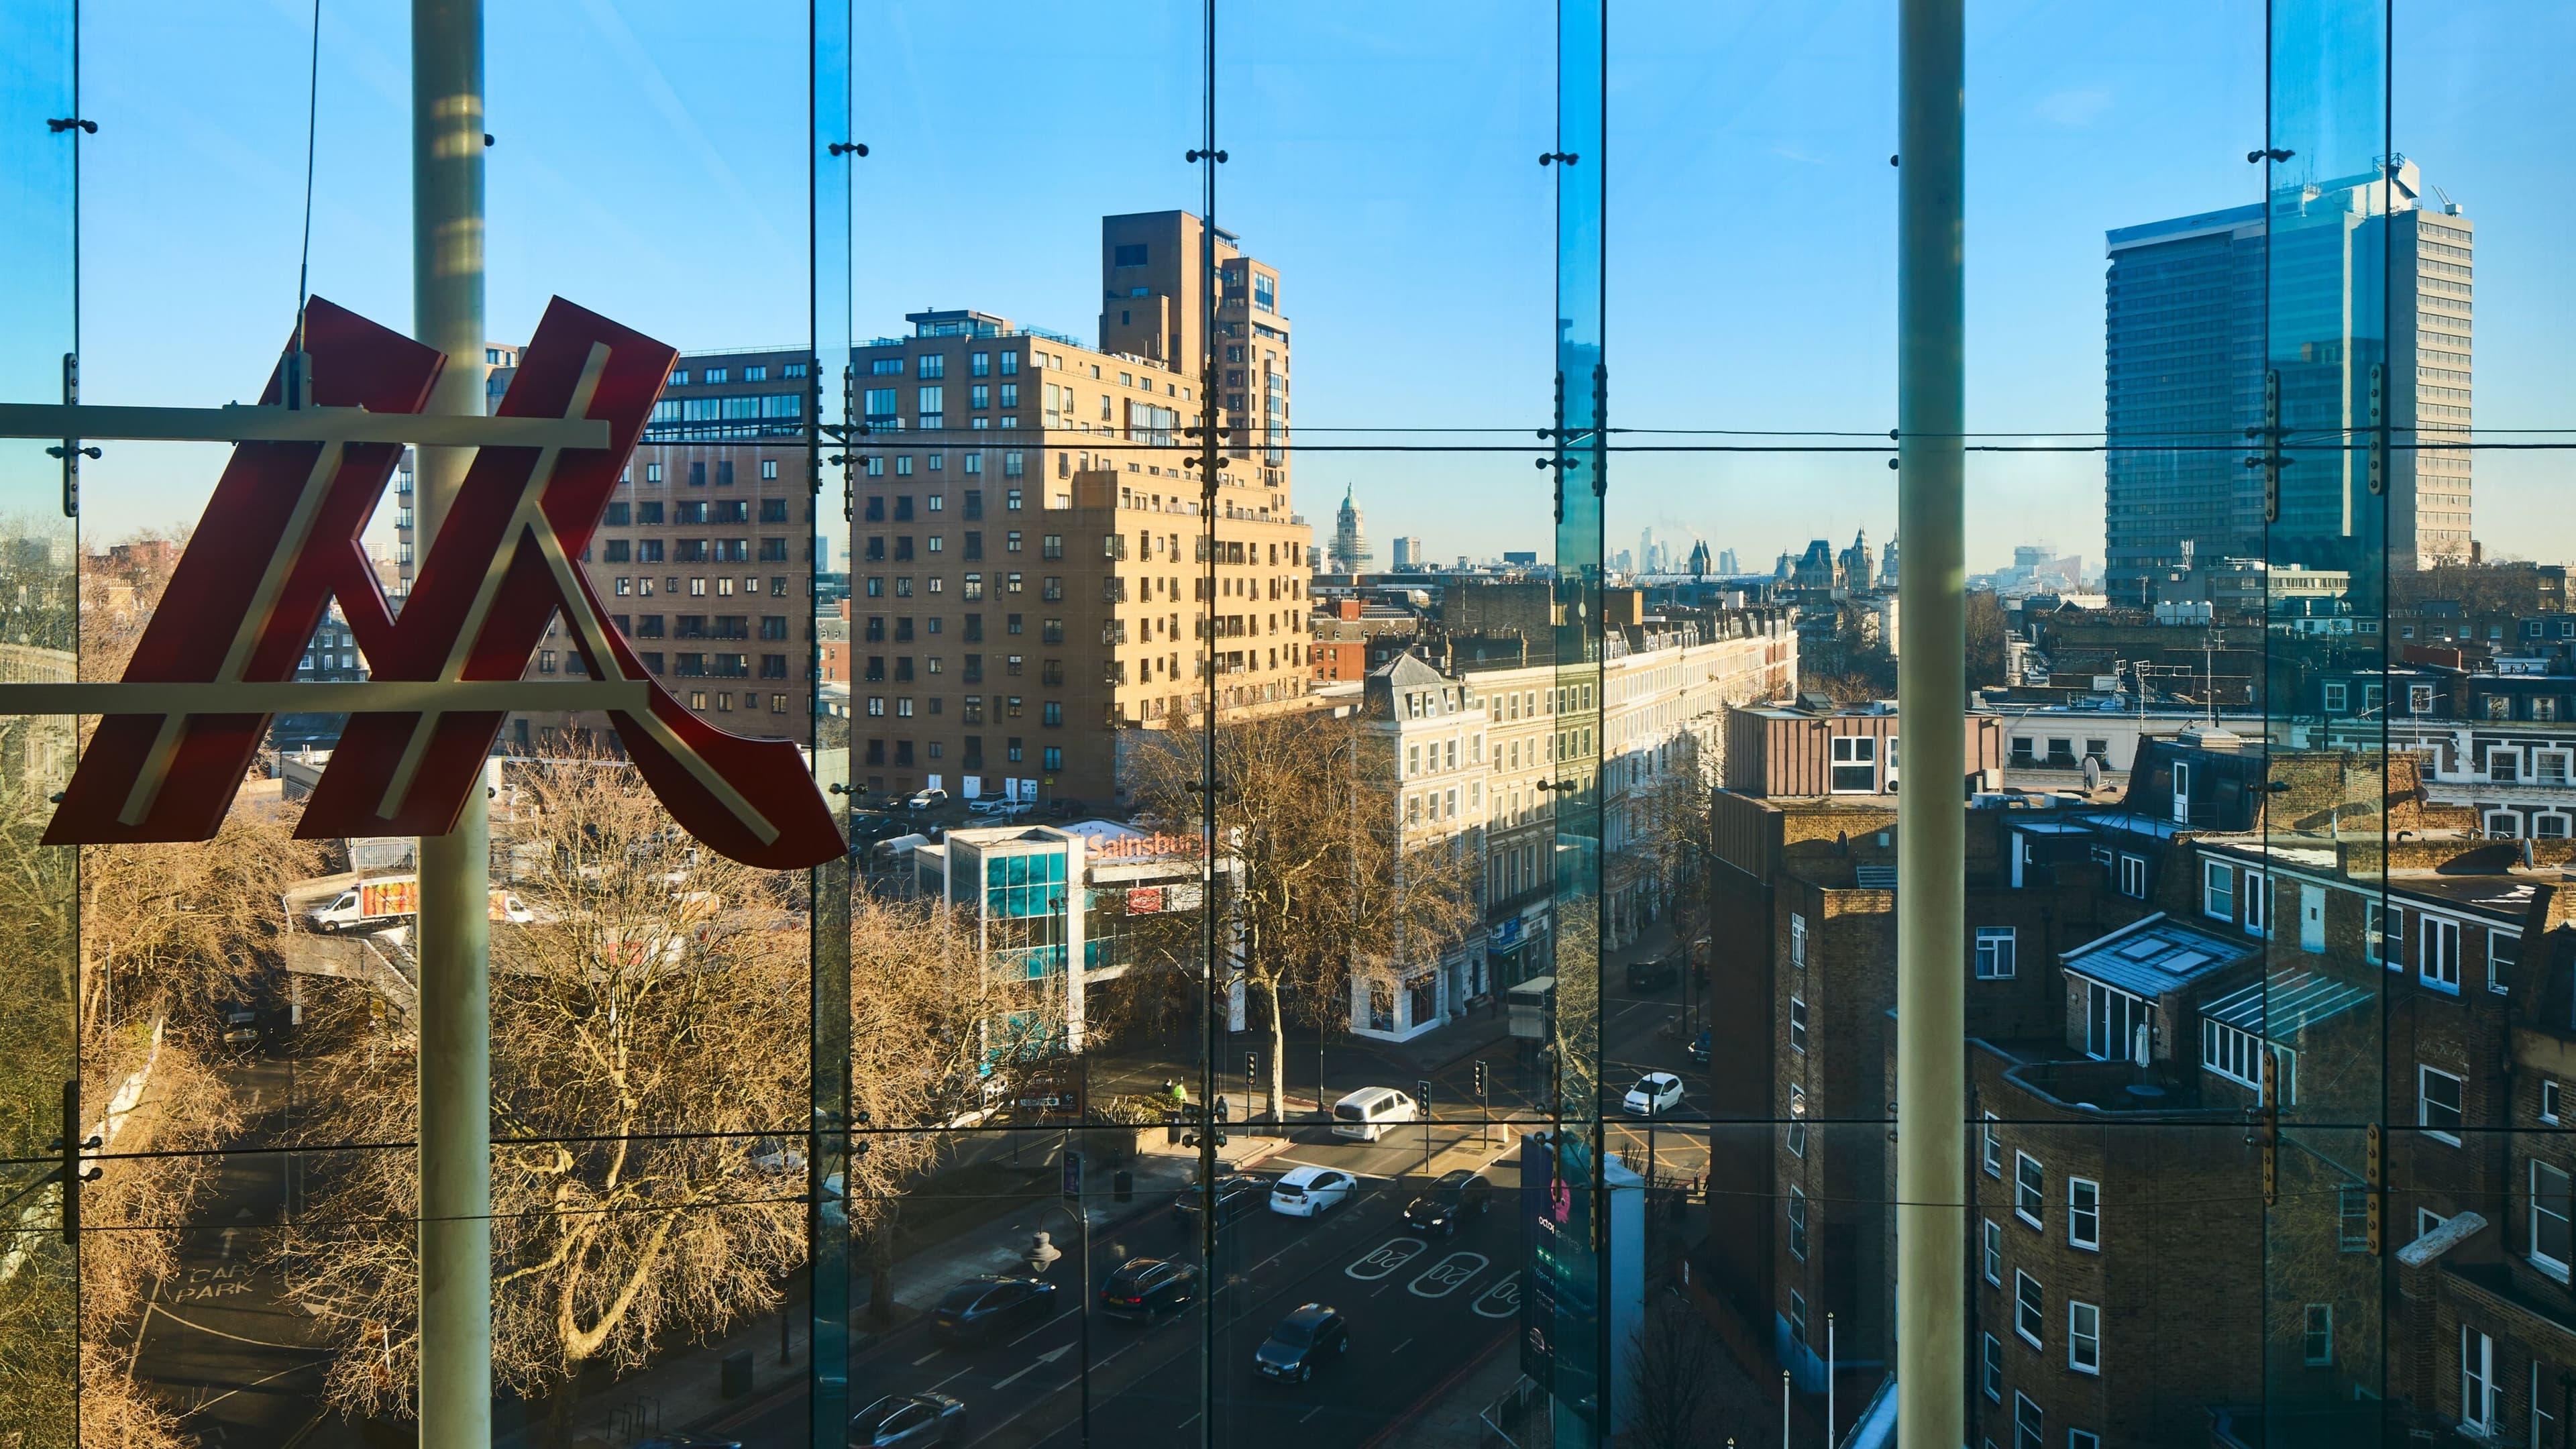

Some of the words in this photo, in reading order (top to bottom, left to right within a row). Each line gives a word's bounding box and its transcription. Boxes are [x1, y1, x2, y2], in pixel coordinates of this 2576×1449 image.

[1366, 1249, 1408, 1268] 20
[189, 1264, 248, 1283] CAR
[1428, 1265, 1471, 1285] 20
[174, 1279, 254, 1303] PARK
